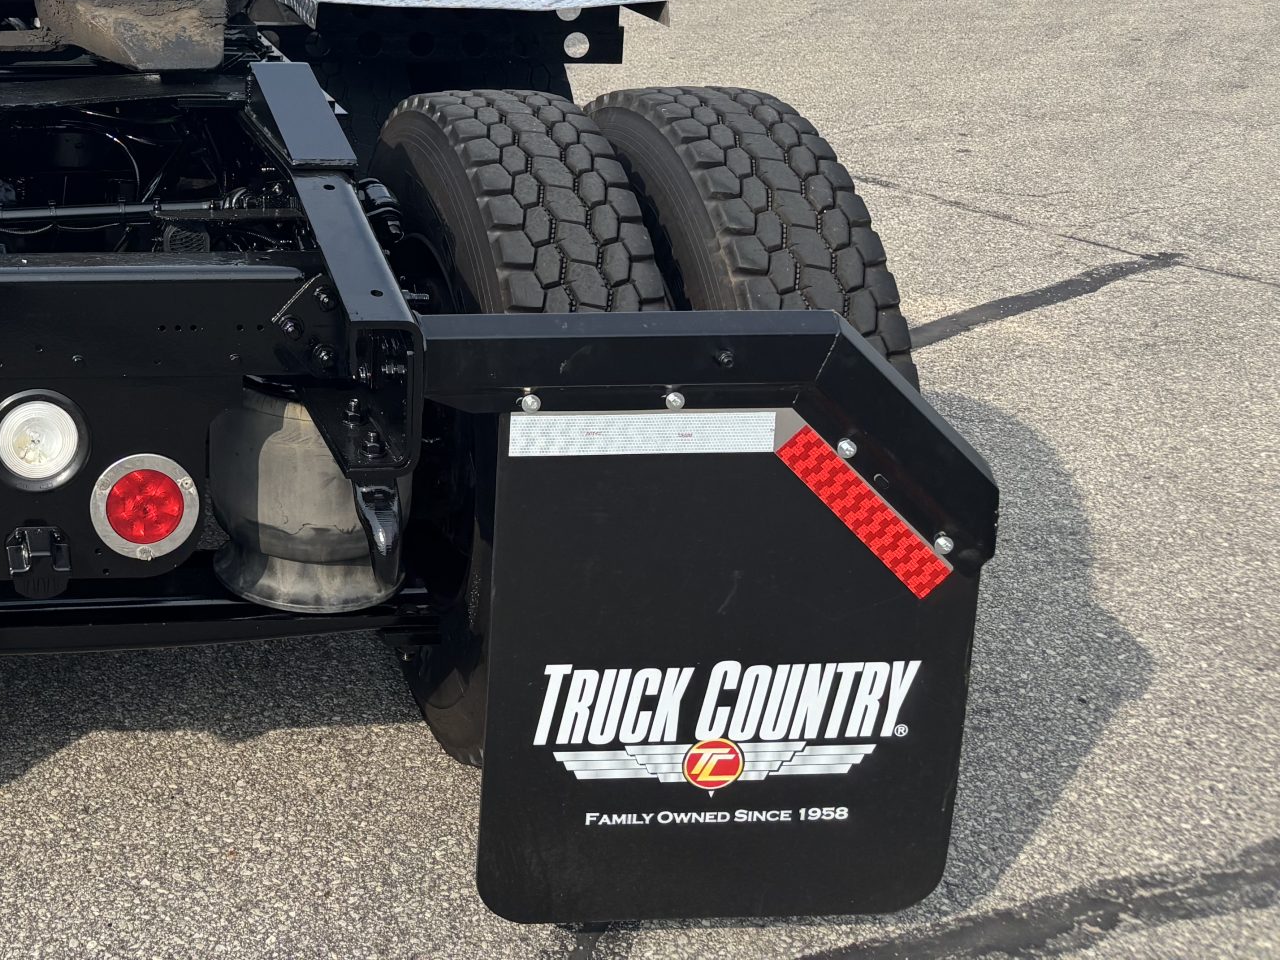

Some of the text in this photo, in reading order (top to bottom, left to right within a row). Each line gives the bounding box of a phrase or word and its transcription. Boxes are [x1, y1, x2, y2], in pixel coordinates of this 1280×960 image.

[533, 659, 923, 746] TRUCK COUNTRY
[585, 806, 849, 826] FAMILY OWNED SINCE 1958
